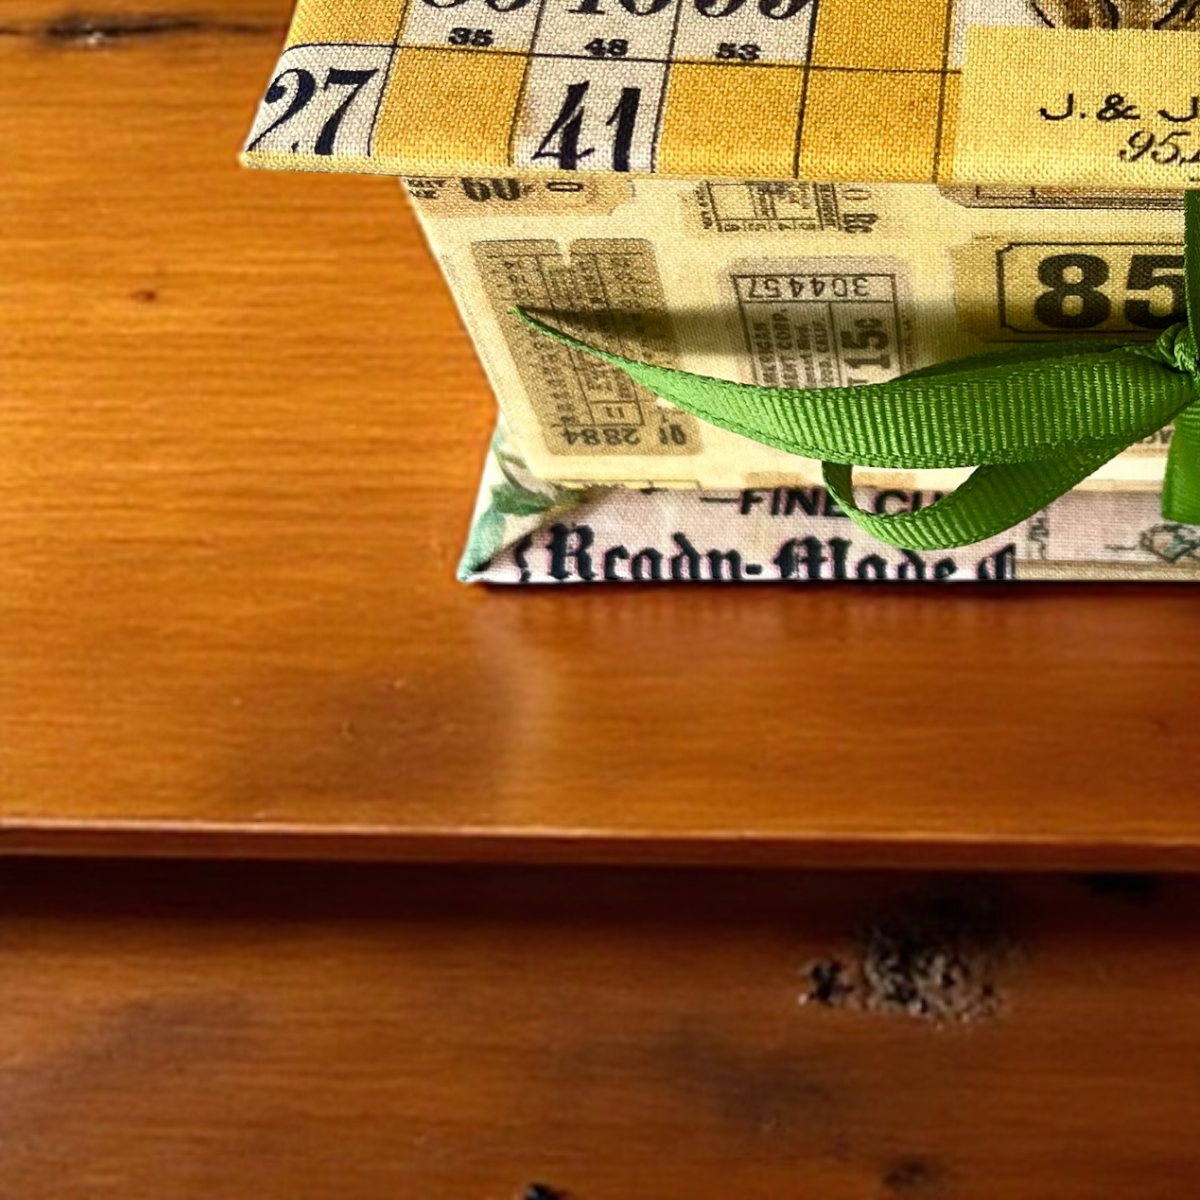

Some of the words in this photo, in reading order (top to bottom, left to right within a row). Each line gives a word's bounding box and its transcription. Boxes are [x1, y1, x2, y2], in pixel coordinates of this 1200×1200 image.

[448, 27, 493, 47] 35
[584, 38, 629, 58] 48
[715, 43, 760, 62] 53
[248, 67, 380, 156] 27
[532, 80, 641, 173] 41
[750, 276, 869, 298] 304457
